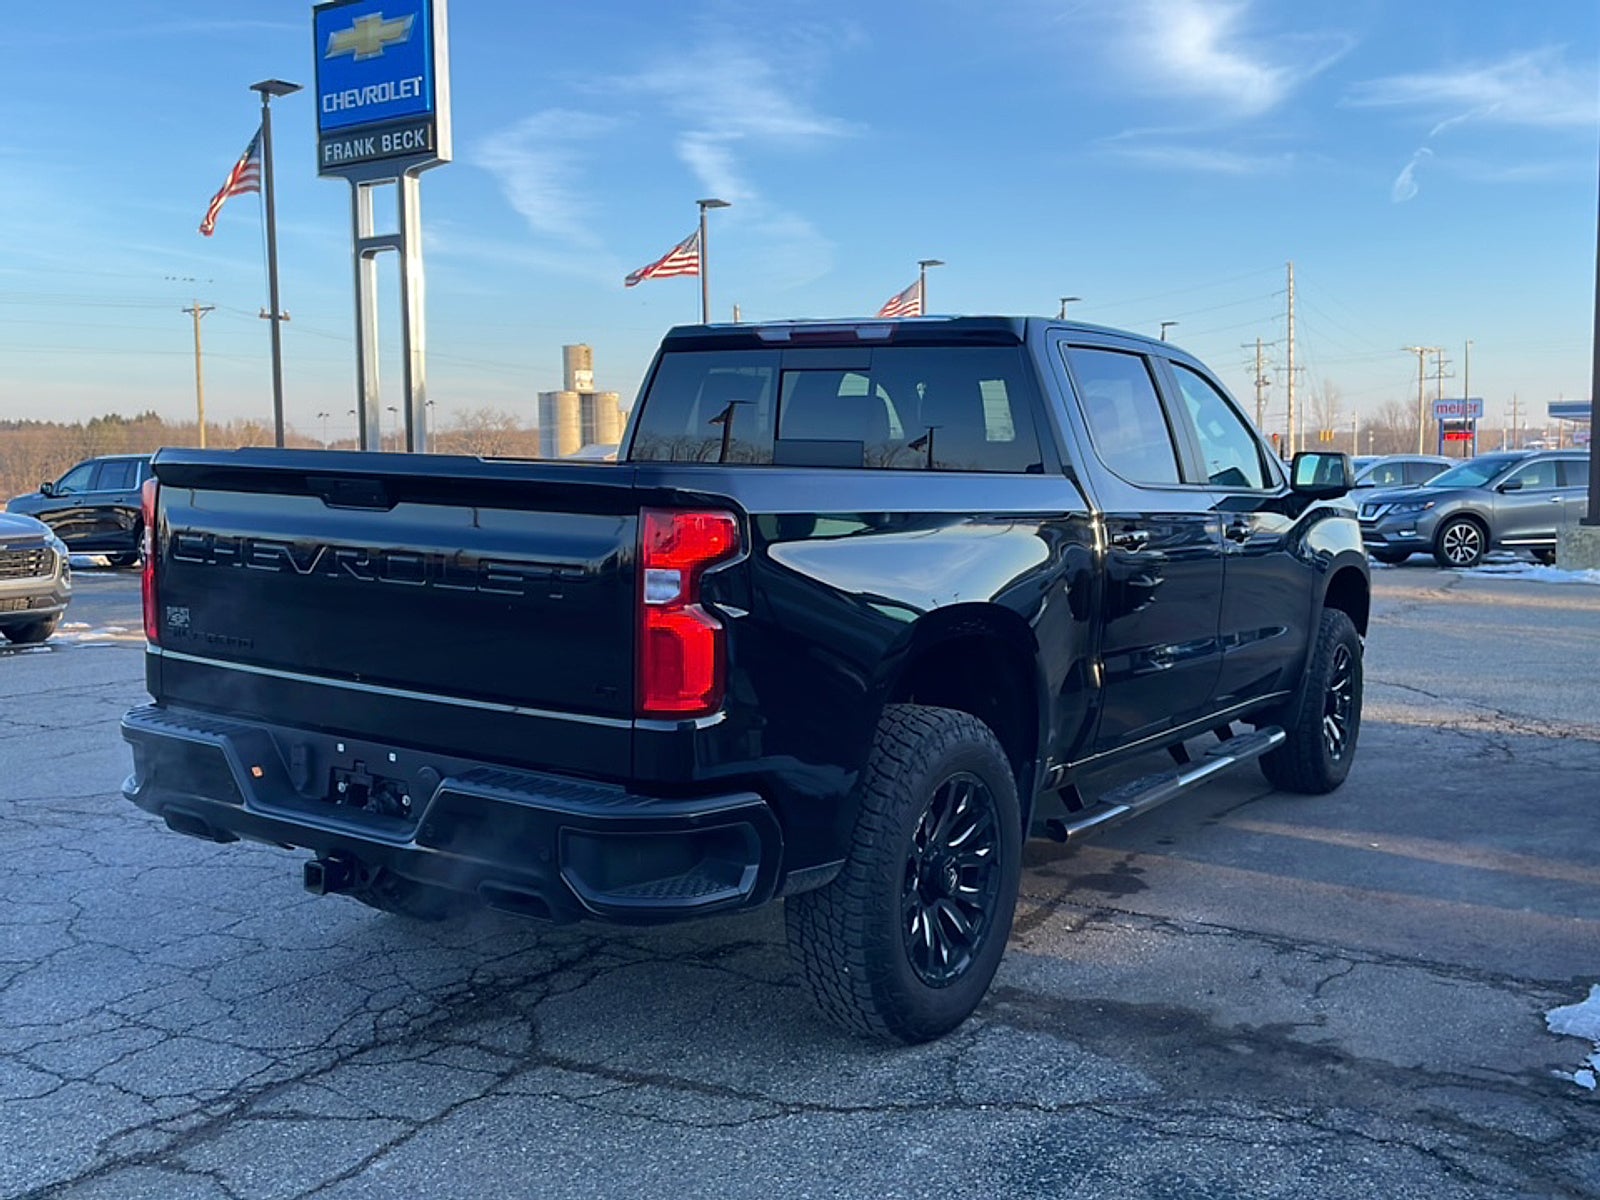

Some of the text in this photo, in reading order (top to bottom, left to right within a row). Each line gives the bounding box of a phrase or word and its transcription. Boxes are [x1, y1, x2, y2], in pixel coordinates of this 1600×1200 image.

[323, 76, 423, 113] CHEVROLET
[324, 128, 425, 162] FRANK BECK
[172, 533, 587, 599] CHEVROLET
